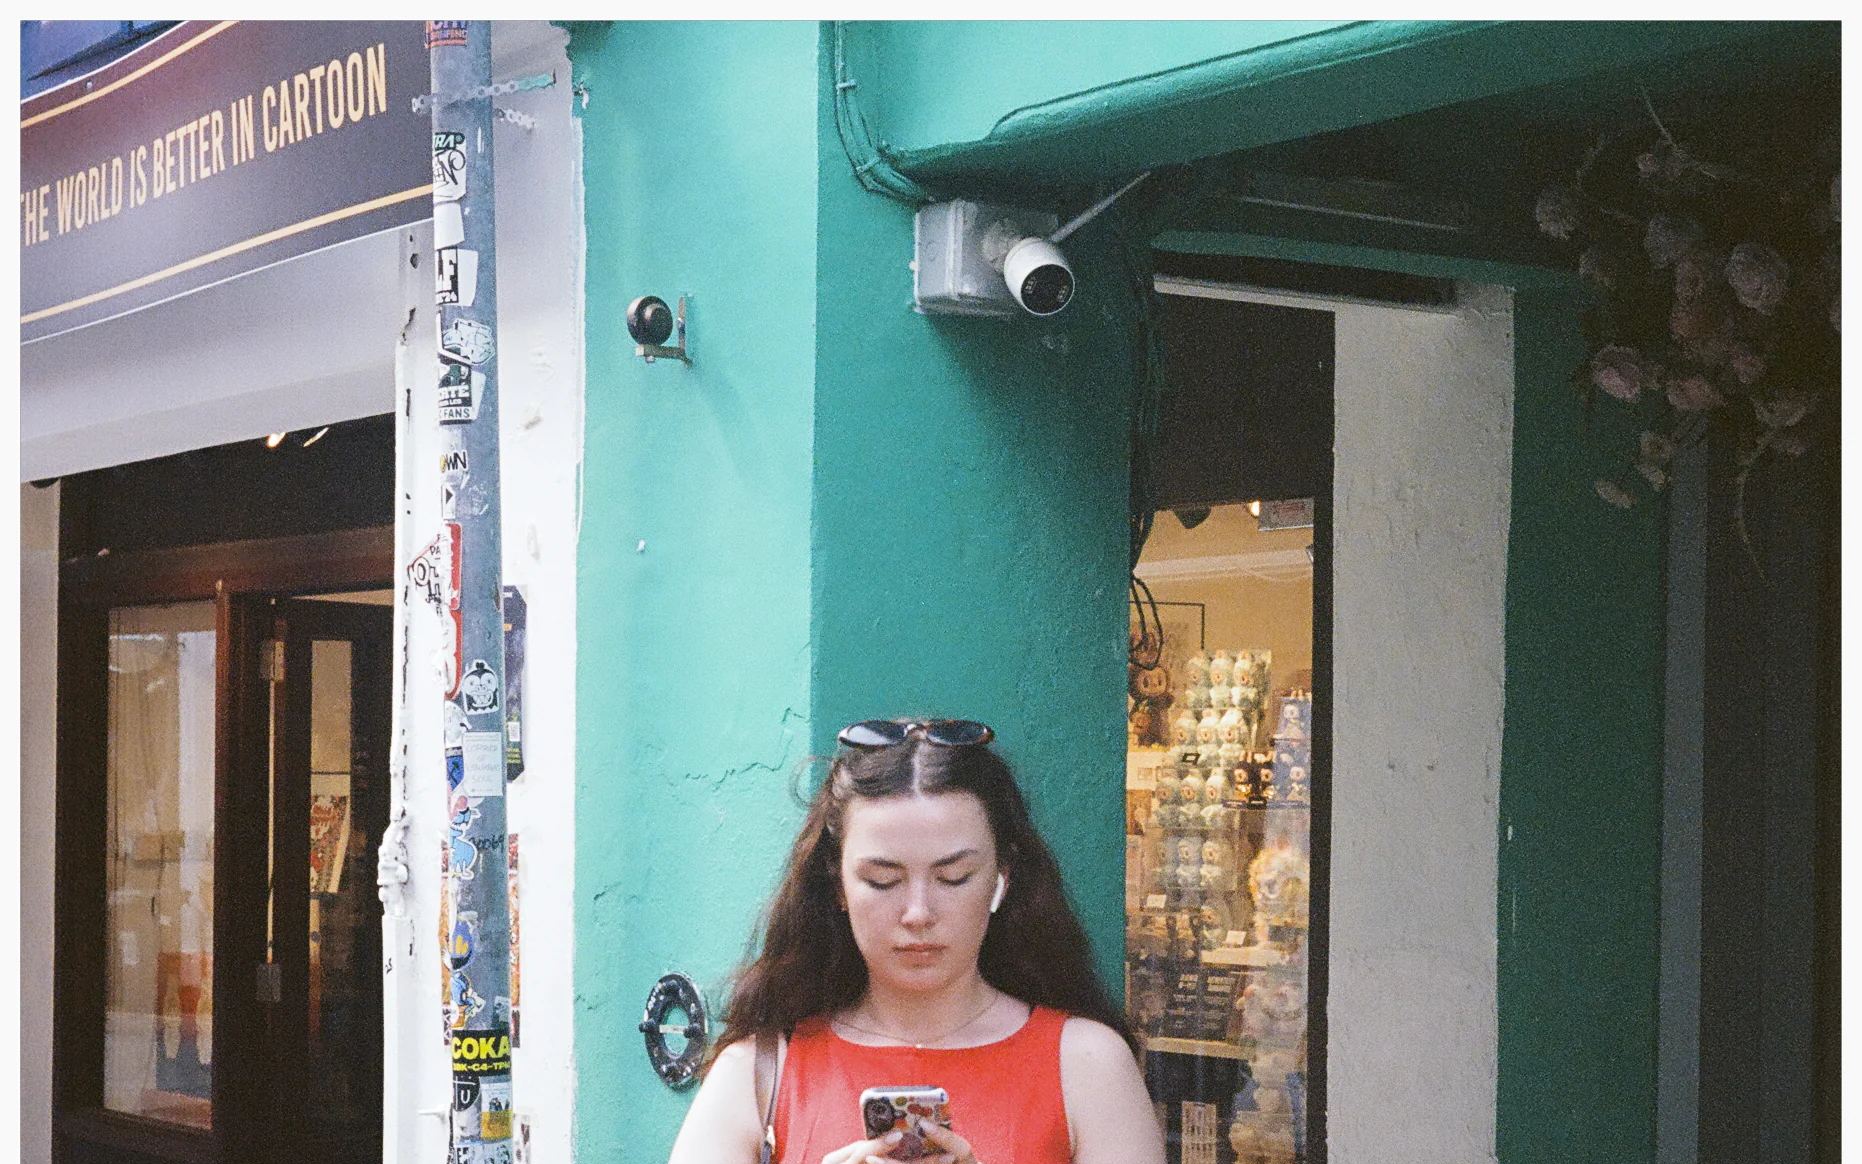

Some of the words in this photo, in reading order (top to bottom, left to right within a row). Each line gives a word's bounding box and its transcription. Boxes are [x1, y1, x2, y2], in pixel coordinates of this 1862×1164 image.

[56, 156, 123, 236] WORLD
[129, 145, 147, 210] IS
[153, 109, 226, 200] BETTER
[231, 94, 255, 167] IN
[262, 42, 387, 153] CARTOON
[452, 1035, 512, 1060] COKA
